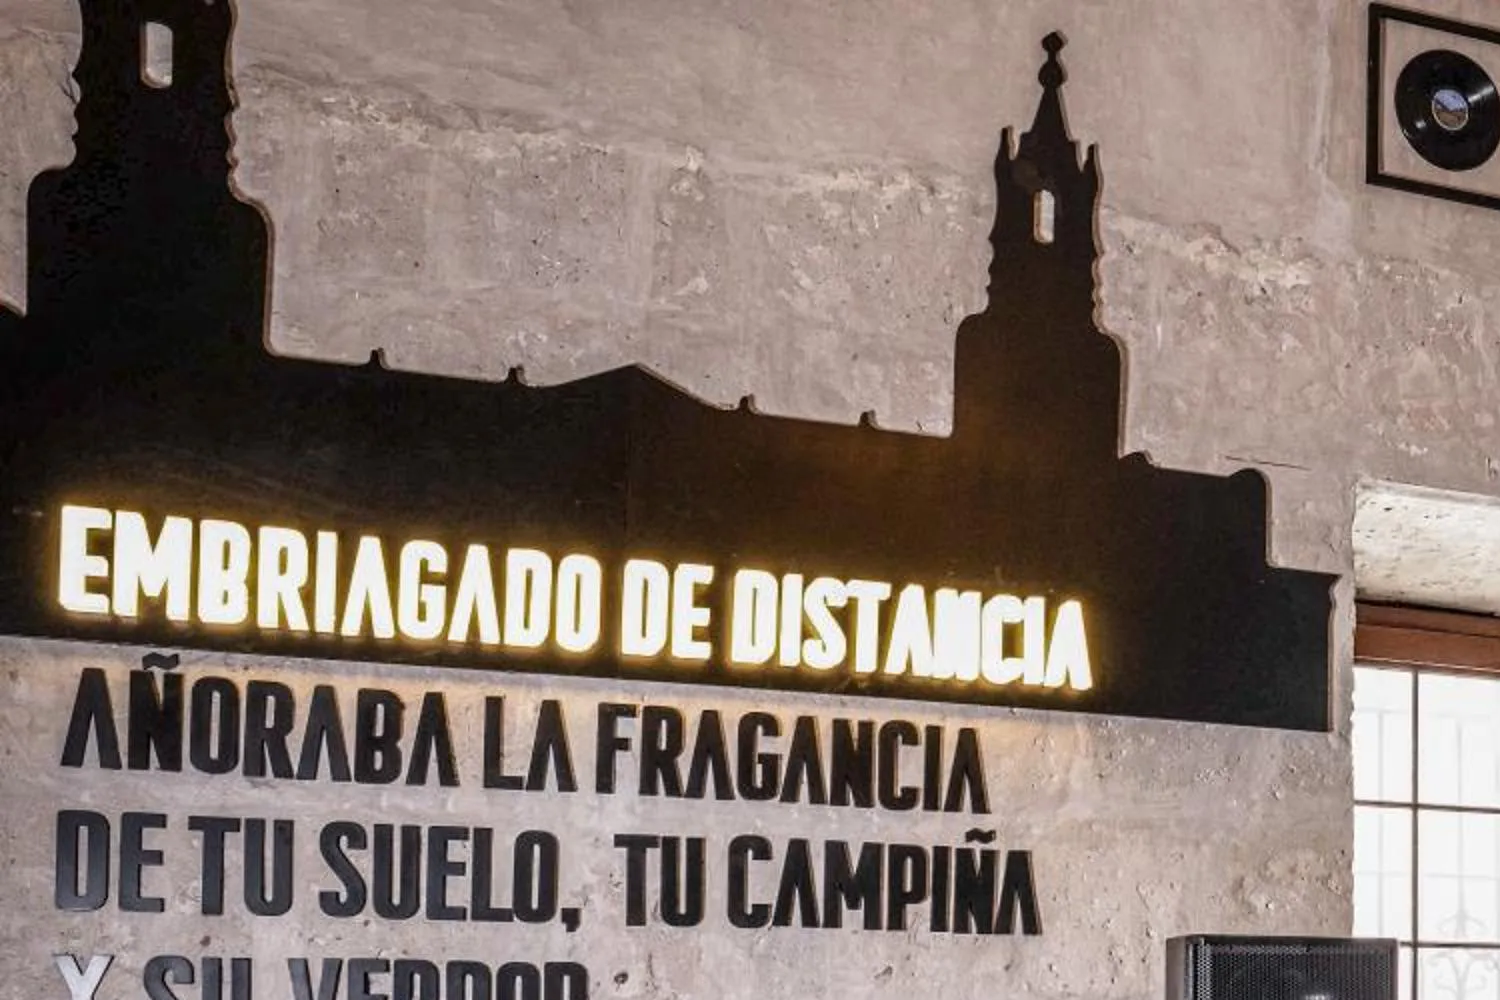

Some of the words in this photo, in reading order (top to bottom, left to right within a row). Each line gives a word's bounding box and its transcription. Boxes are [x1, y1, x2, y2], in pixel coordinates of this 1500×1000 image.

[58, 504, 601, 653] EMBRIAGADO
[621, 559, 714, 660] DE
[731, 568, 1093, 691] DISTANCIA
[60, 652, 460, 787] AÑORABA
[482, 695, 578, 792] LA
[595, 702, 992, 815] FRAGANCIA
[54, 809, 167, 913] DE
[188, 816, 295, 917] TU
[318, 821, 582, 932] SUELO,
[613, 833, 707, 928] TU
[727, 827, 1043, 936] CAMPIÑA
